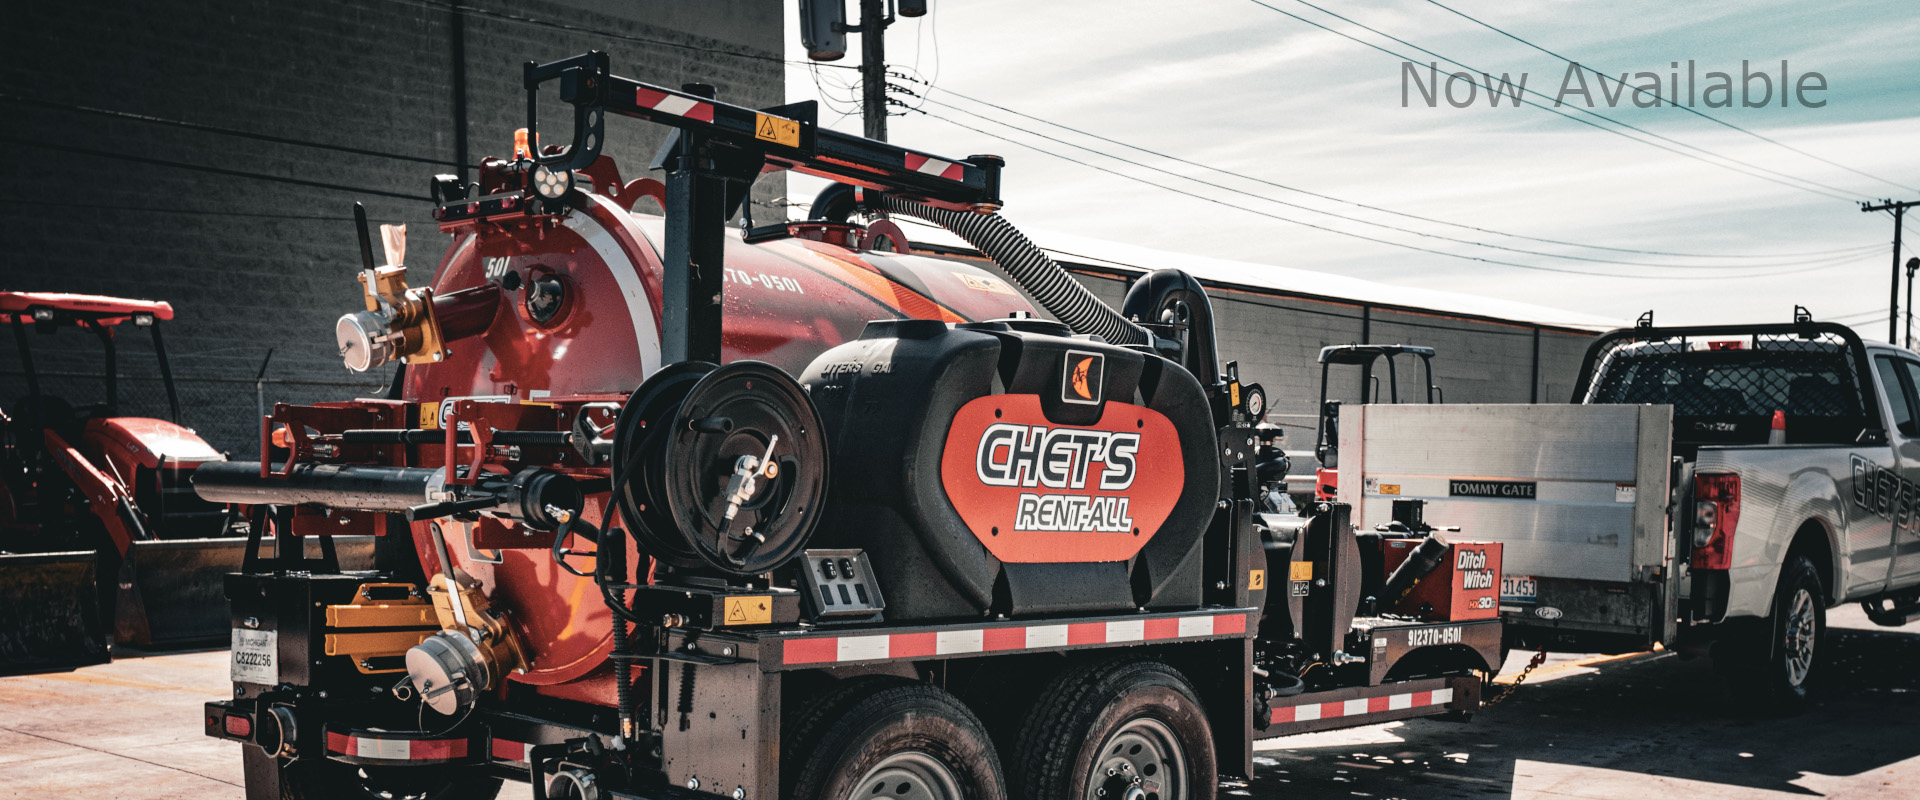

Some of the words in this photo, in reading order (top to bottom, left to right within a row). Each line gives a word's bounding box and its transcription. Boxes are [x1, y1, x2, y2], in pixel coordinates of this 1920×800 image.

[485, 255, 511, 279] 501
[723, 267, 805, 295] 70-0501
[976, 422, 1142, 492] CHET'S
[1451, 482, 1499, 495] TOMMY
[1501, 484, 1534, 496] GATE
[1849, 452, 1913, 530] CHET'S
[1013, 492, 1133, 534] RENT-ALL
[1456, 549, 1487, 571] Ditch
[1463, 569, 1494, 590] Witch
[1502, 578, 1536, 596] 31453
[1407, 626, 1462, 647] 912370-0501
[235, 651, 272, 668] C8222256
